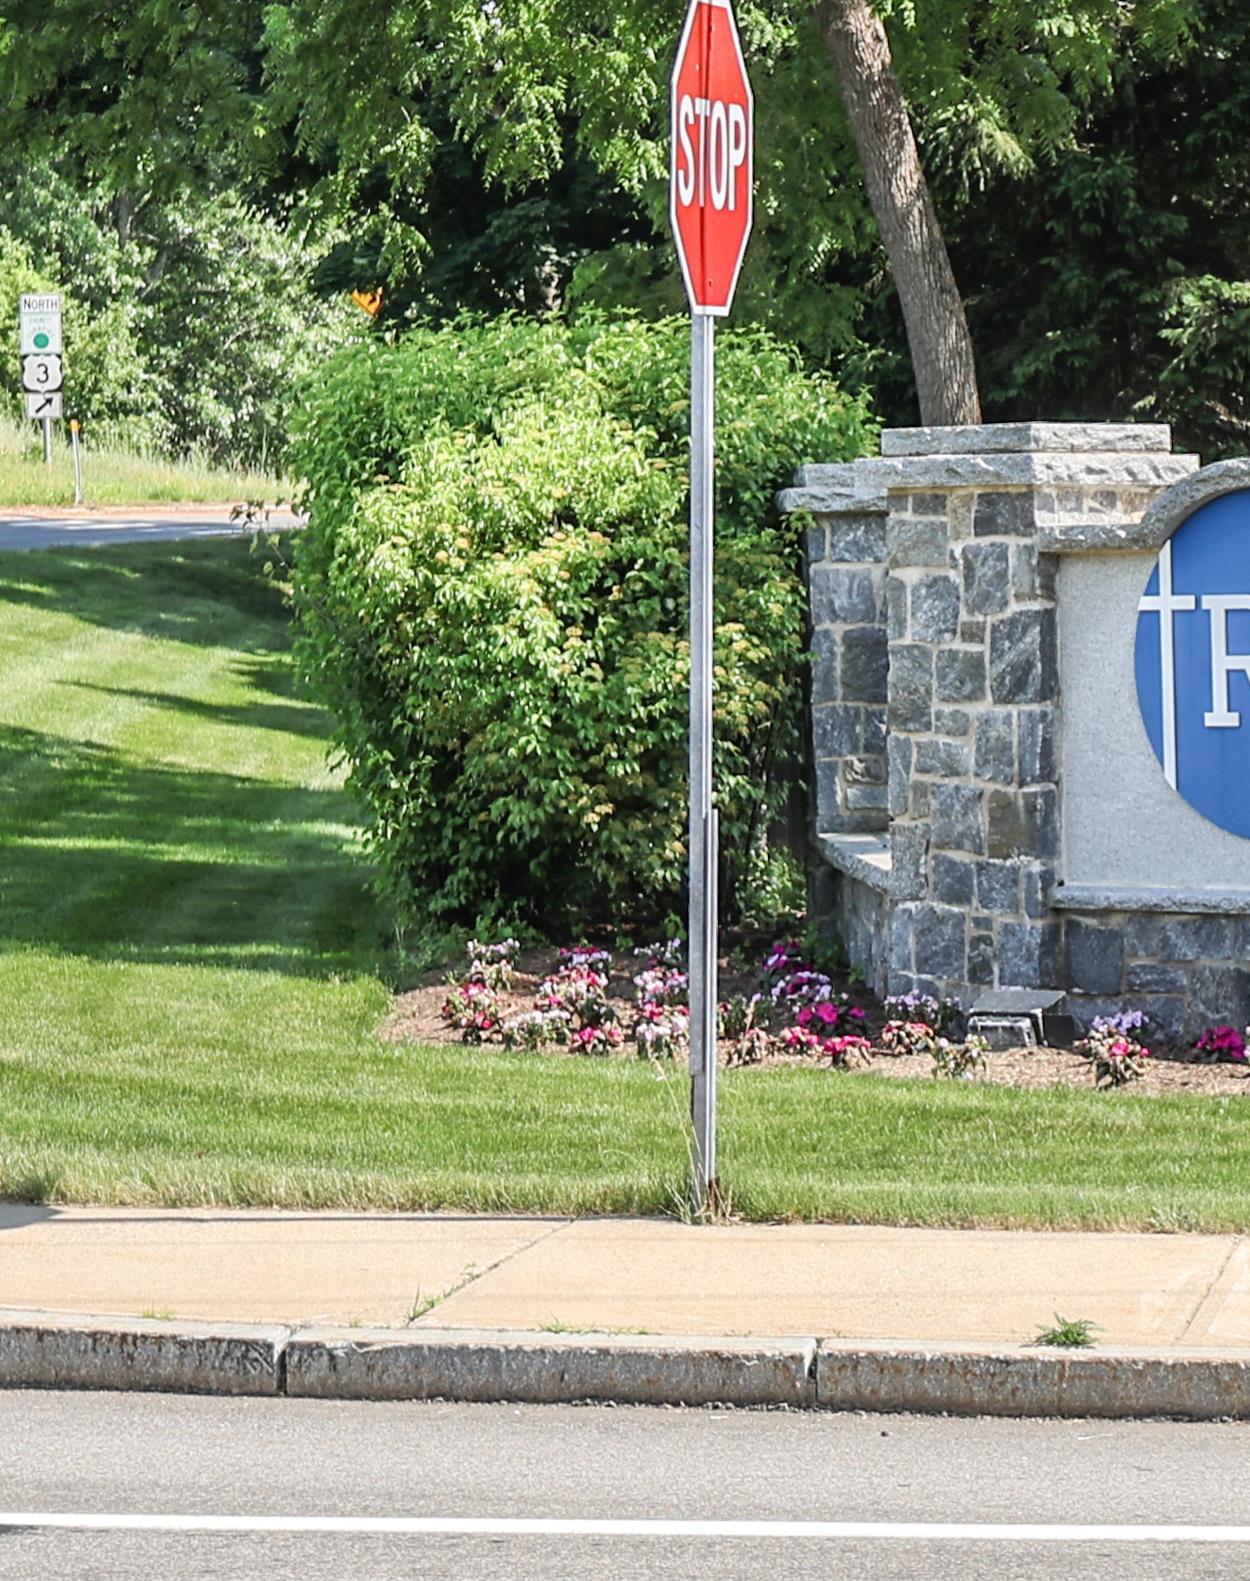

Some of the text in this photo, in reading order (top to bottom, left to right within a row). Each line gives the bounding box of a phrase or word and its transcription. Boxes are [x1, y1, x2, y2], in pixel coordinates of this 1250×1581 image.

[677, 94, 747, 212] STOP
[24, 298, 58, 310] NORTH
[36, 363, 50, 384] 3
